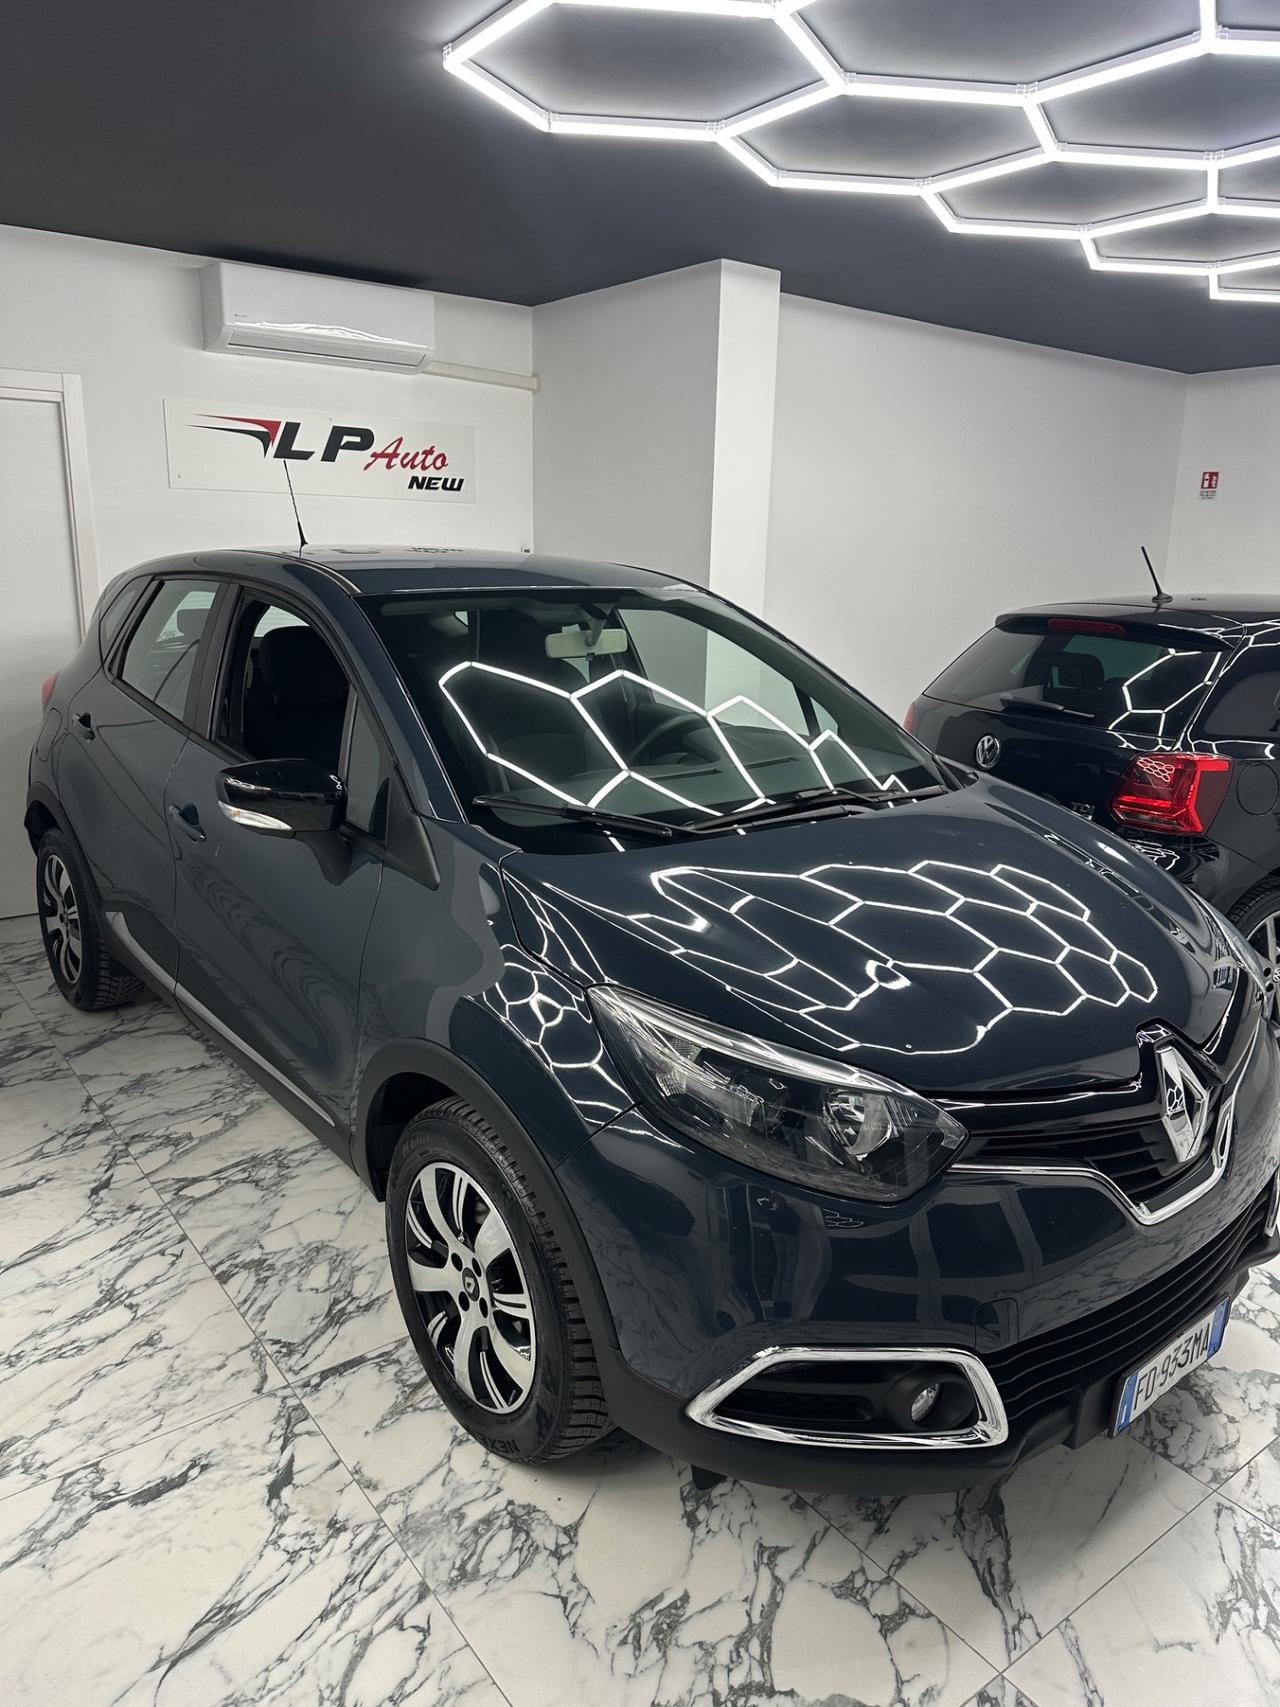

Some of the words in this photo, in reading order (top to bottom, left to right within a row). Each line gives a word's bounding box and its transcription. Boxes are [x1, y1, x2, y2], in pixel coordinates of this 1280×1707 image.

[363, 436, 448, 470] Auto
[408, 476, 464, 492] NEW
[1134, 1366, 1157, 1410] FD
